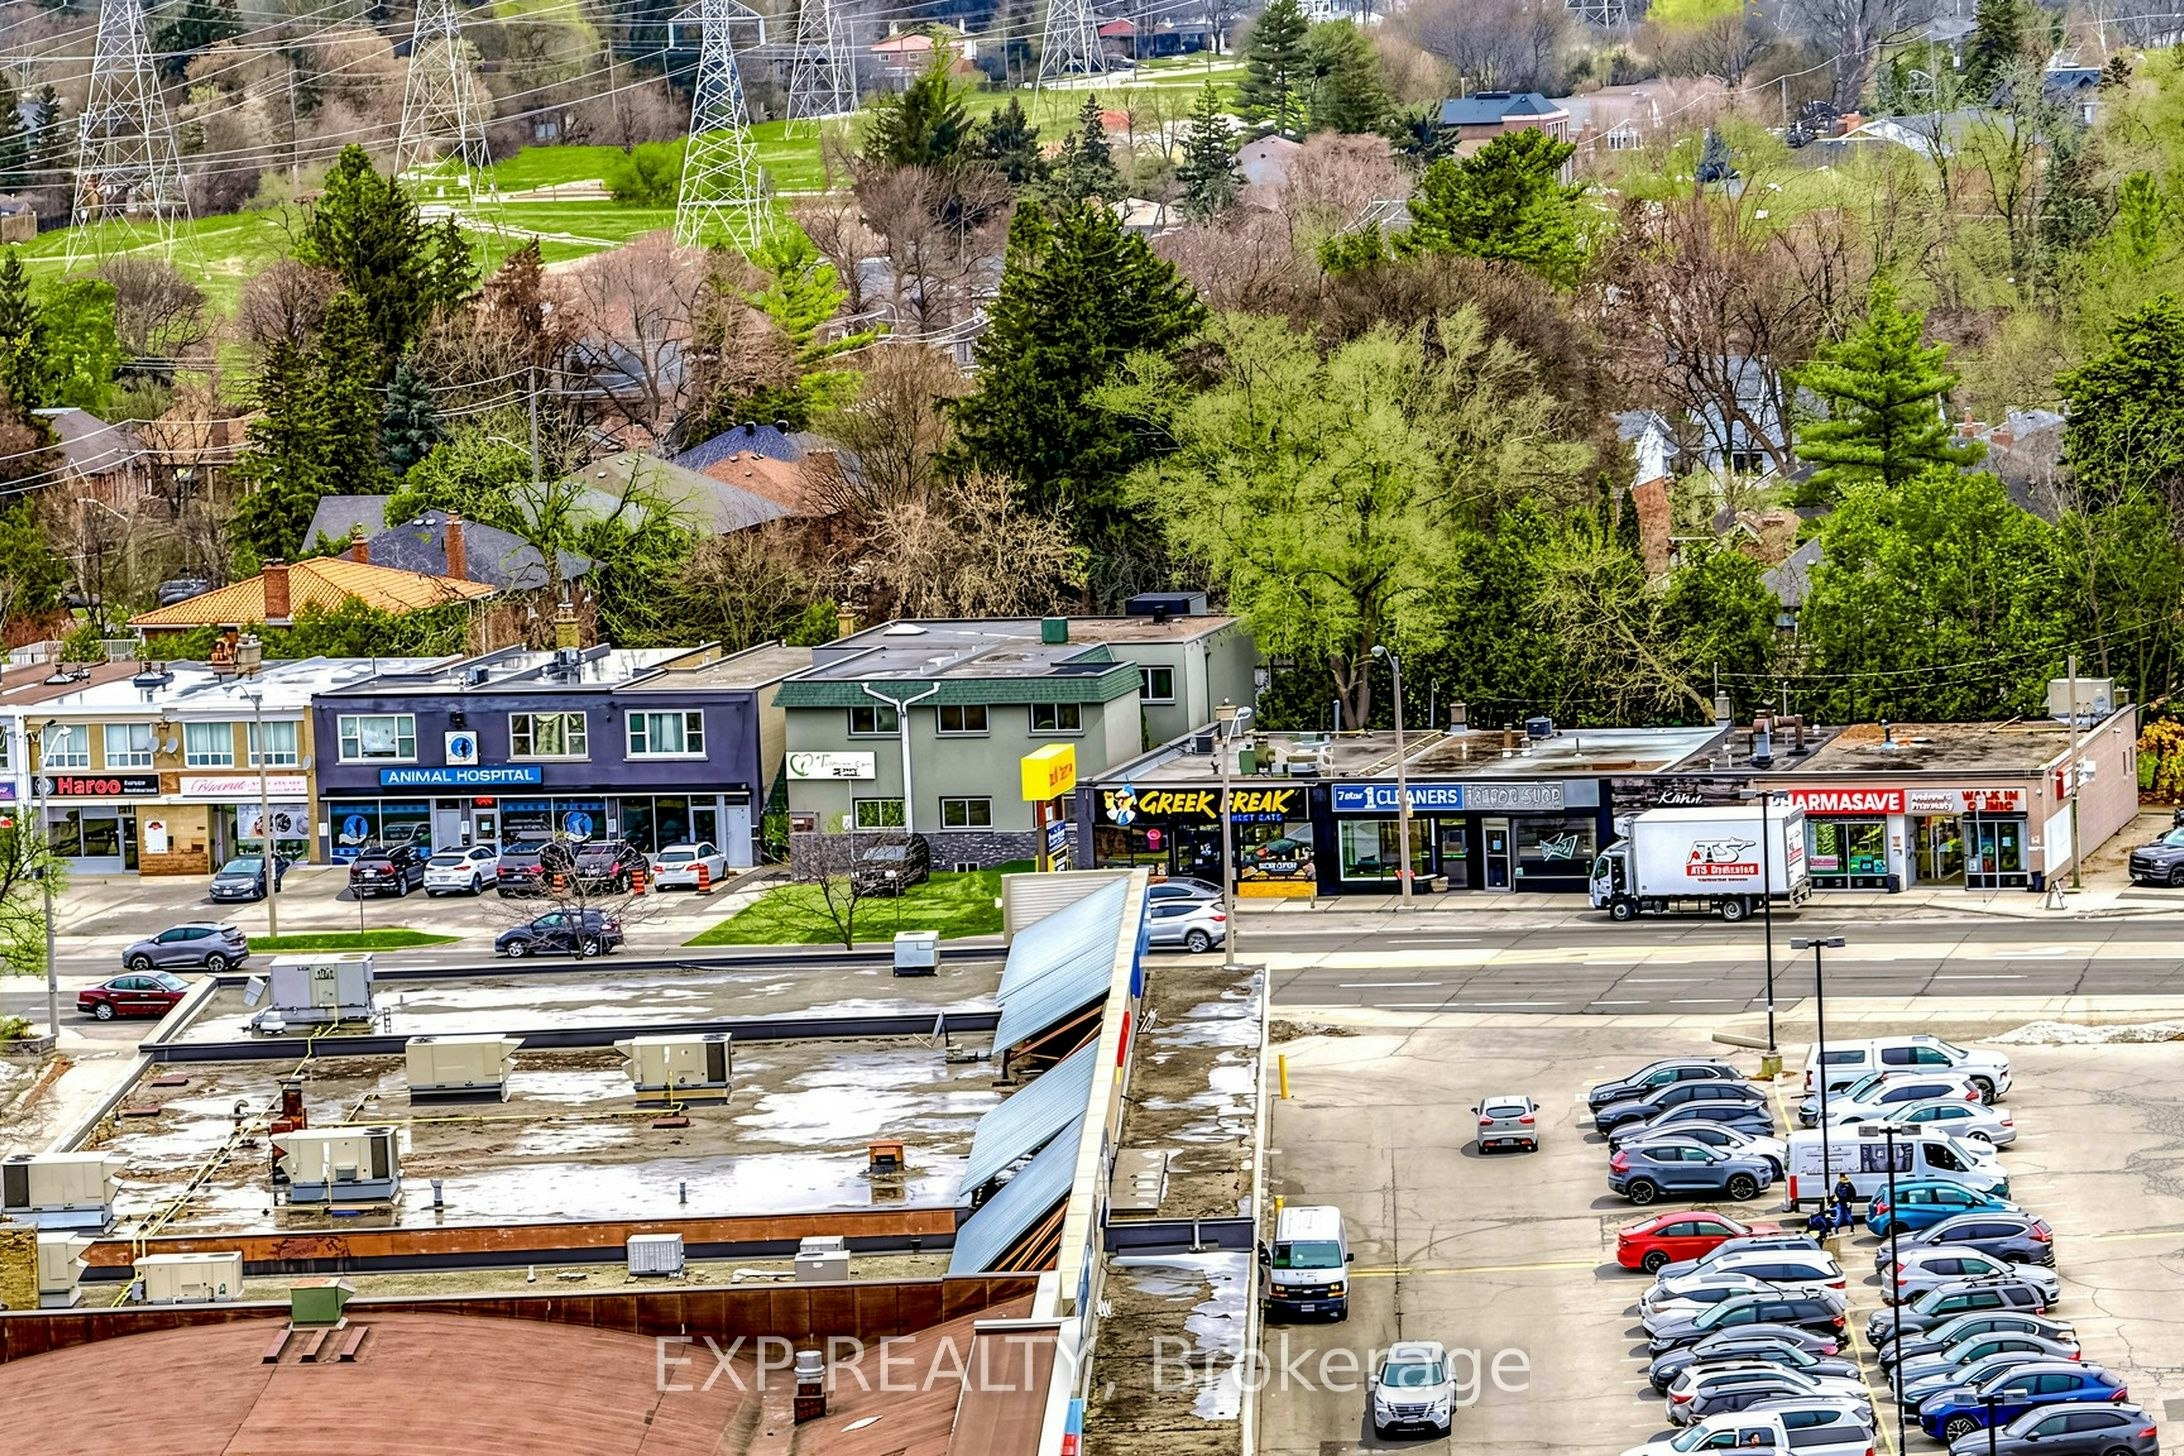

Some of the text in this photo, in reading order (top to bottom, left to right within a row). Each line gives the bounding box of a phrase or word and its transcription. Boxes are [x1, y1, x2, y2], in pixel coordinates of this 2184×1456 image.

[388, 769, 534, 783] ANIMAL HOSPITAL
[57, 776, 121, 794] Haroo
[2004, 791, 2019, 800] IN
[1139, 790, 1217, 819] GREEK
